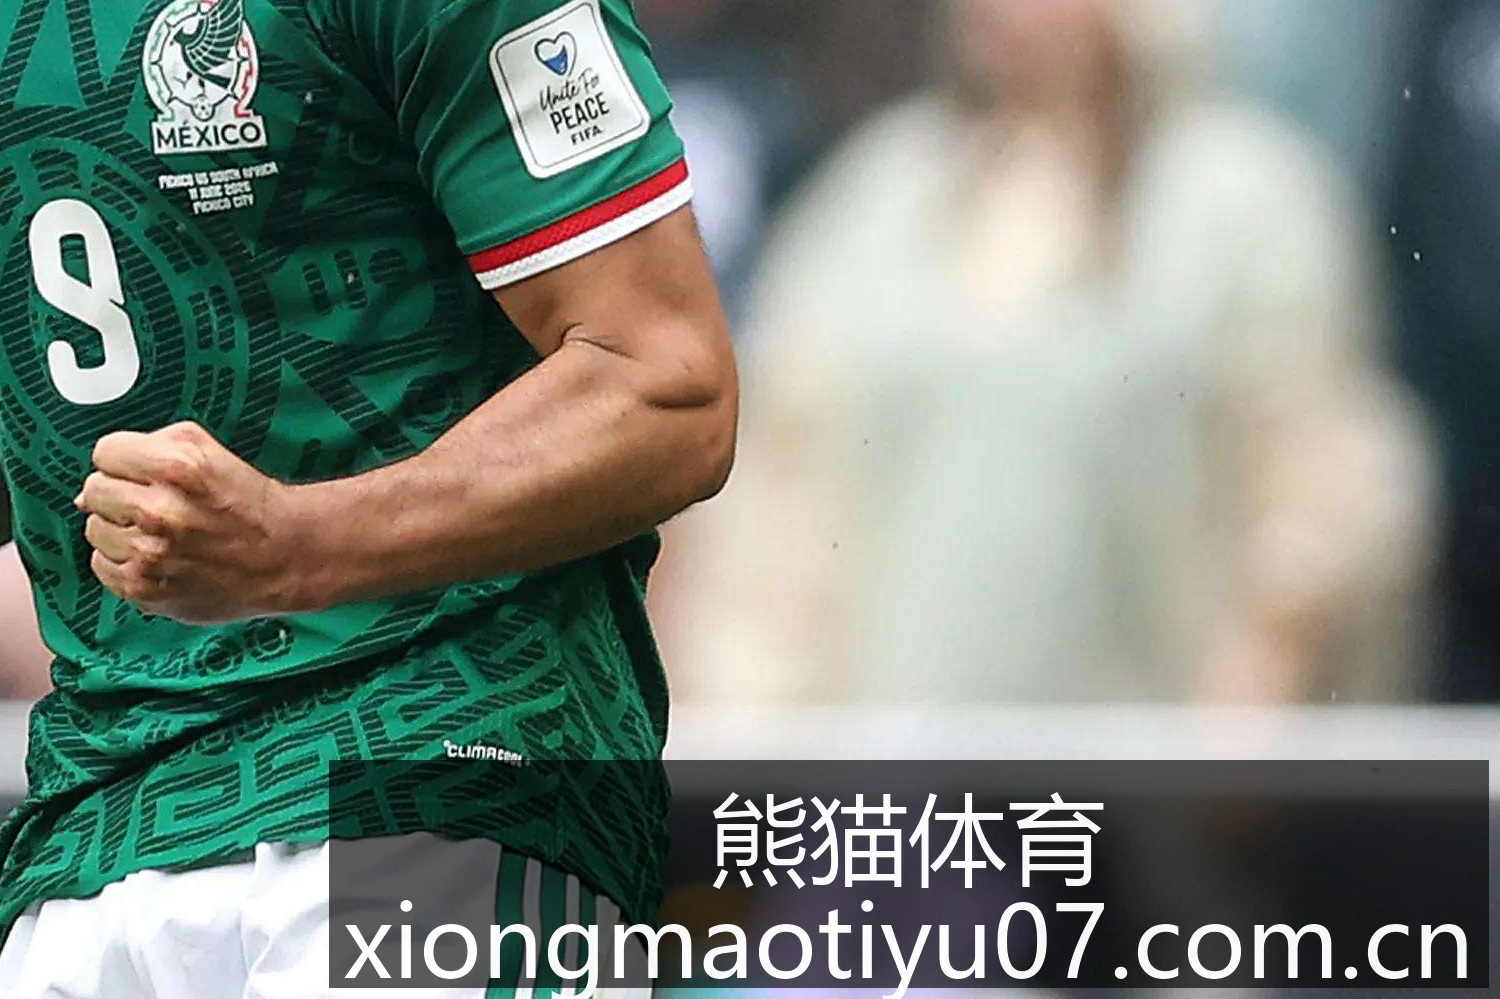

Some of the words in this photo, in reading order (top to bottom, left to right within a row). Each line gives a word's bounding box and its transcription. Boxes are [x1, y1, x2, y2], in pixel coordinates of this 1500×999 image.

[549, 91, 610, 135] PEACE
[156, 119, 261, 149] MÉXICO
[570, 125, 604, 146] FIFA
